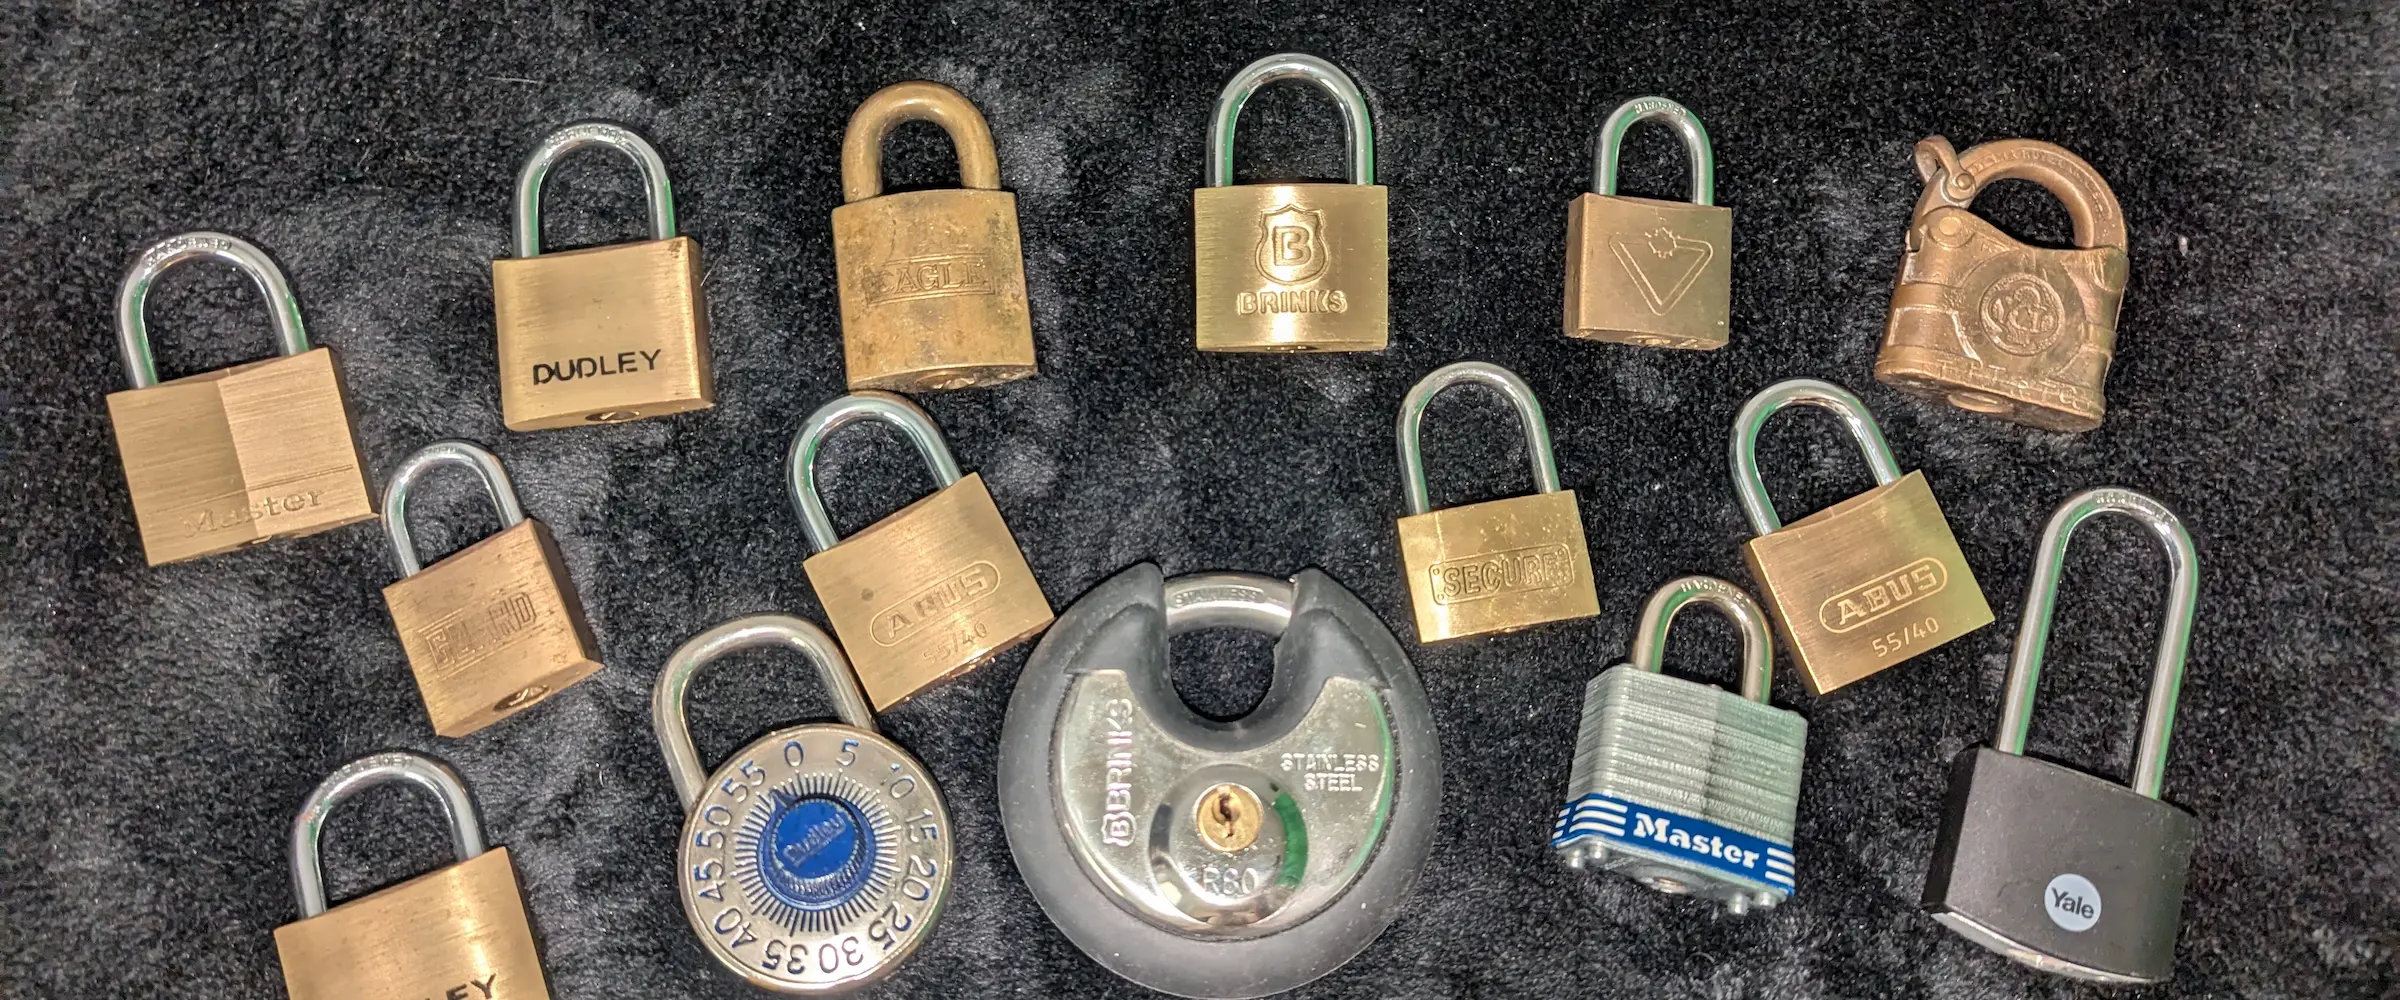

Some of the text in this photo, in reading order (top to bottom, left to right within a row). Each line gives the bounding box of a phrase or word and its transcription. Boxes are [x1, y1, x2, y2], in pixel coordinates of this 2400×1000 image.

[1274, 226, 1312, 266] B
[1237, 290, 1347, 315] BRINKS
[532, 349, 661, 385] DUDLEY
[180, 490, 324, 538] Master
[1443, 552, 1560, 597] SECURE
[1837, 565, 1937, 625] ABUS
[886, 568, 988, 639] ABUS
[424, 592, 537, 671] GURD
[923, 621, 988, 663] 55/40
[1872, 617, 1939, 657] 55/40
[784, 741, 804, 767] 0
[836, 739, 859, 767] 5
[1106, 699, 1132, 810] BRINKS
[1281, 753, 1379, 772] STAINLESS
[721, 760, 766, 802] 55
[1304, 773, 1363, 791] STEEL
[696, 805, 732, 849] 50
[905, 808, 938, 843] 15
[1633, 812, 1759, 869] Master
[693, 858, 727, 901] 45
[903, 855, 937, 900] 20
[1203, 867, 1260, 895] R80
[2051, 887, 2094, 919] Yale
[715, 907, 758, 948] 40
[869, 901, 912, 950] 25
[762, 939, 808, 974] 35
[819, 936, 863, 974] 30
